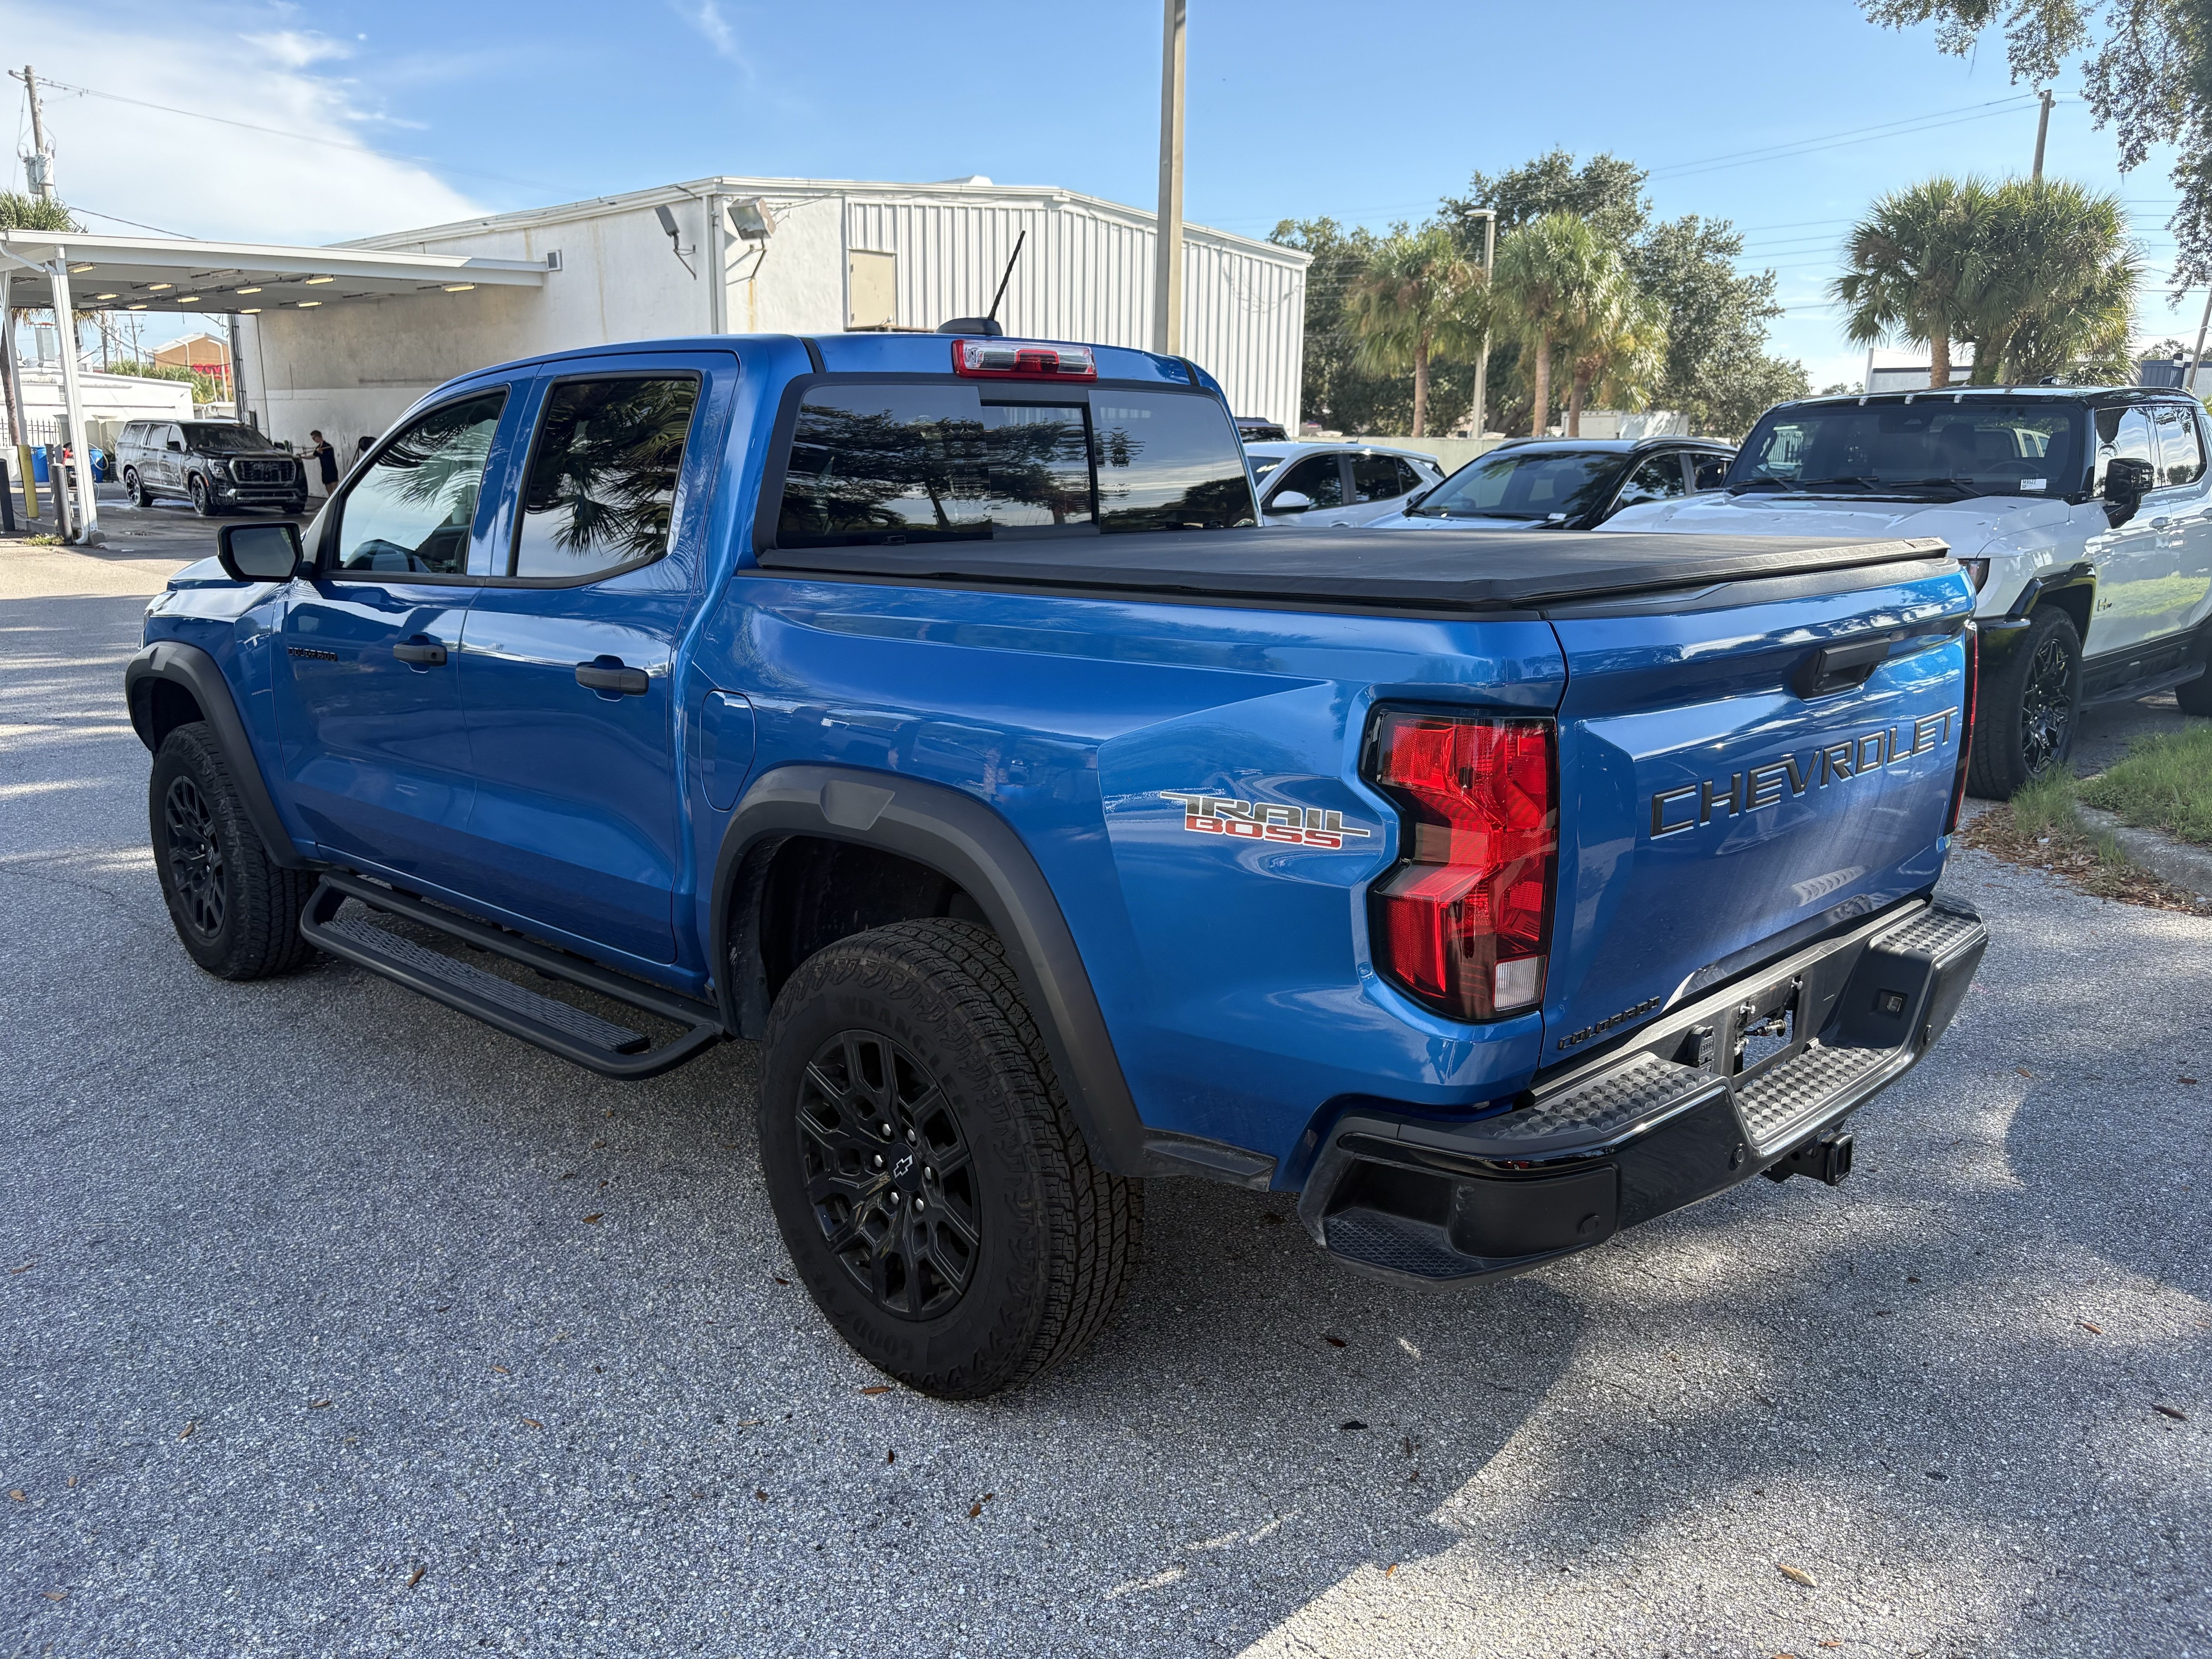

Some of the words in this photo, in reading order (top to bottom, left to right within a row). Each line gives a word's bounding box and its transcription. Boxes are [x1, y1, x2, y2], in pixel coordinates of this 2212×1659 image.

[1650, 706, 1959, 840] CHEVROLET
[1160, 791, 1370, 837] TRAIL
[1185, 815, 1343, 850] BOSS
[1559, 996, 1660, 1049] COLORADO
